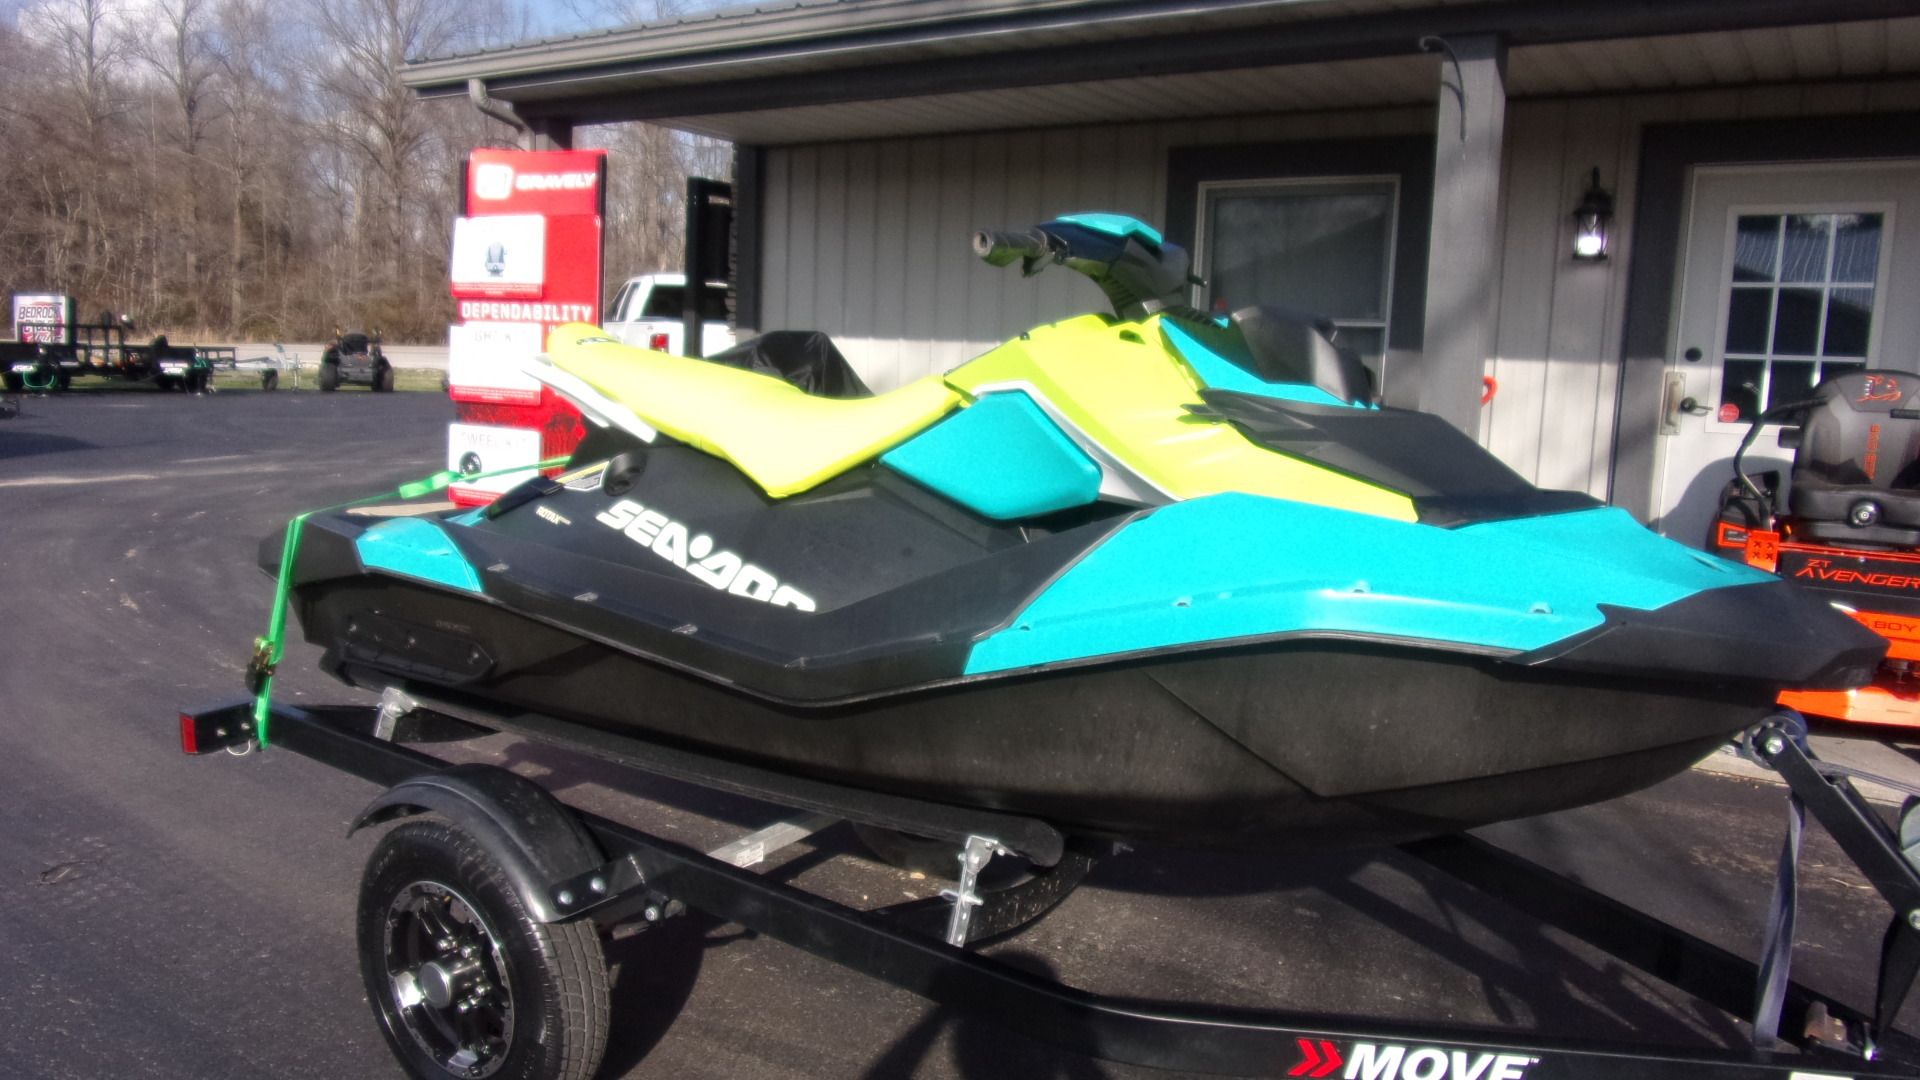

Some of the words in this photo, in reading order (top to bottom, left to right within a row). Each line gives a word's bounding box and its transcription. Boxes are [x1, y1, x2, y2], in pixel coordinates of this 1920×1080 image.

[515, 173, 596, 191] GRAVELY
[19, 306, 59, 320] BEDROCK
[461, 302, 593, 321] DEPENDABILITY
[535, 506, 563, 525] ROTAX
[1807, 559, 1832, 568] ZT
[1795, 567, 1920, 588] AVENGER
[1874, 620, 1919, 632] BOY
